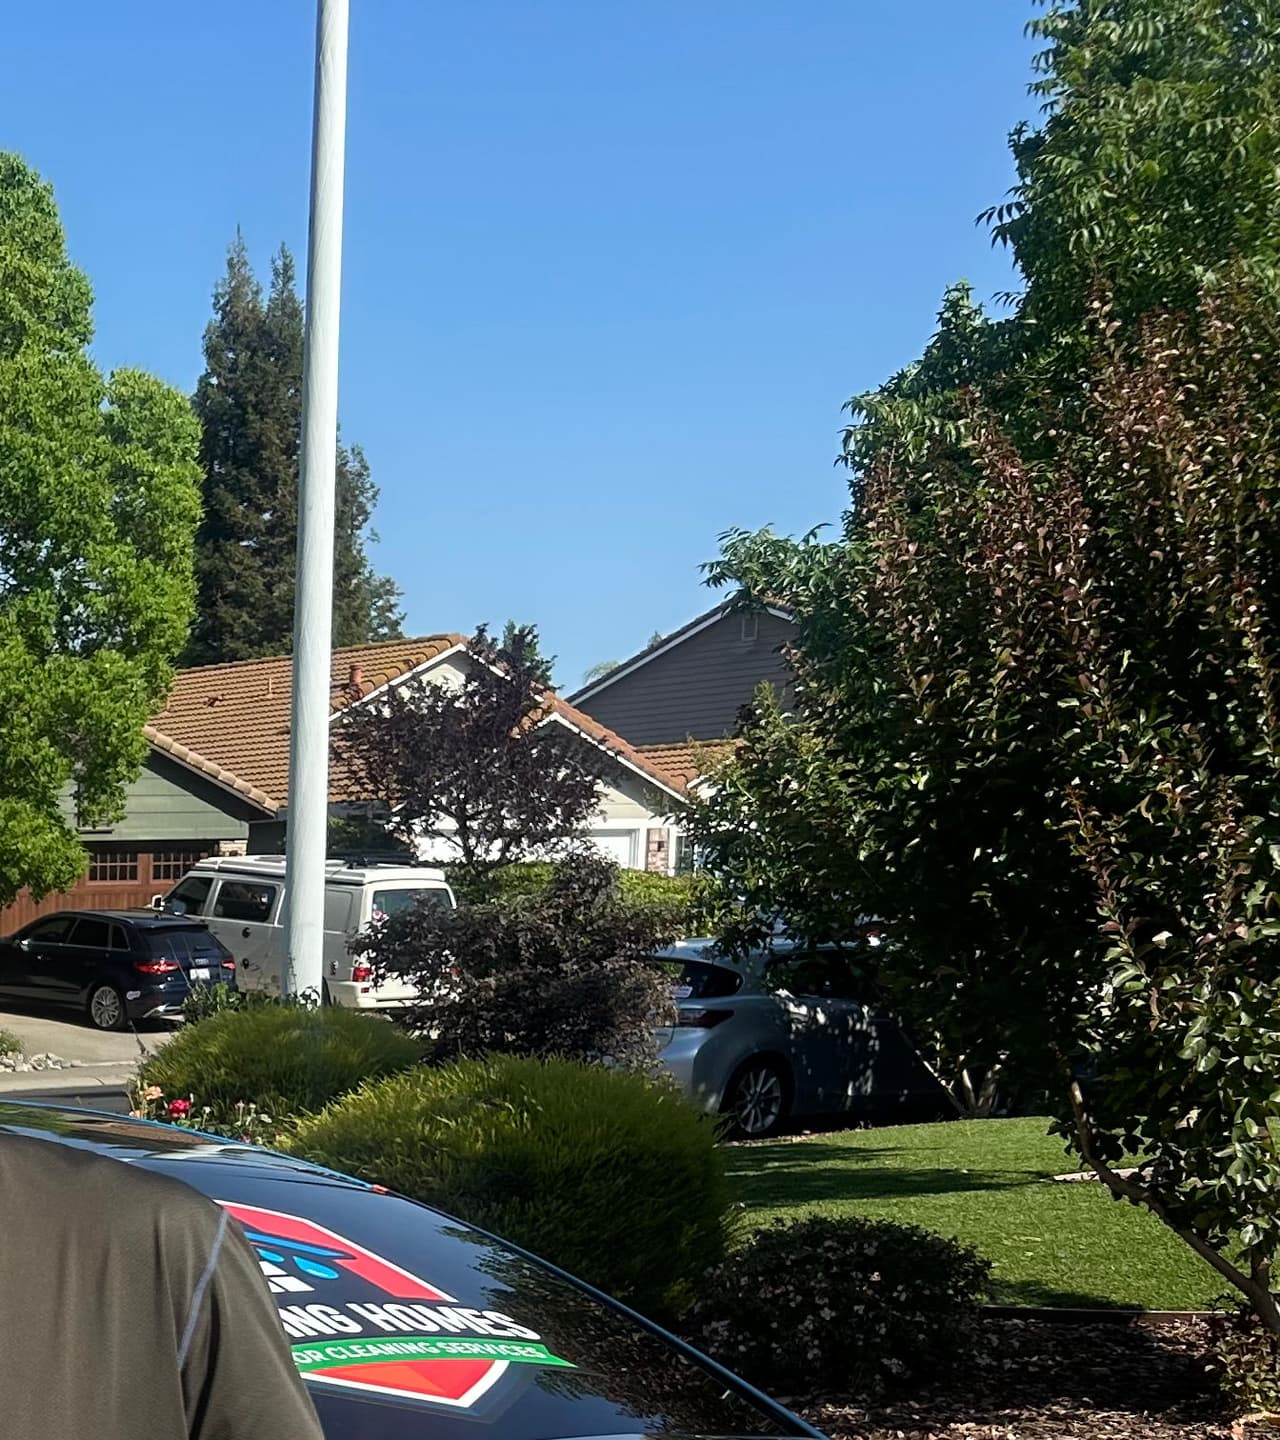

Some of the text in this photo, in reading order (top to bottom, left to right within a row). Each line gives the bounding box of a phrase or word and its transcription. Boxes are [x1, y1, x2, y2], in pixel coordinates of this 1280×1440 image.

[345, 1303, 541, 1340] HOMES
[324, 1342, 437, 1360] CLEANING
[437, 1341, 547, 1359] SERVICES
